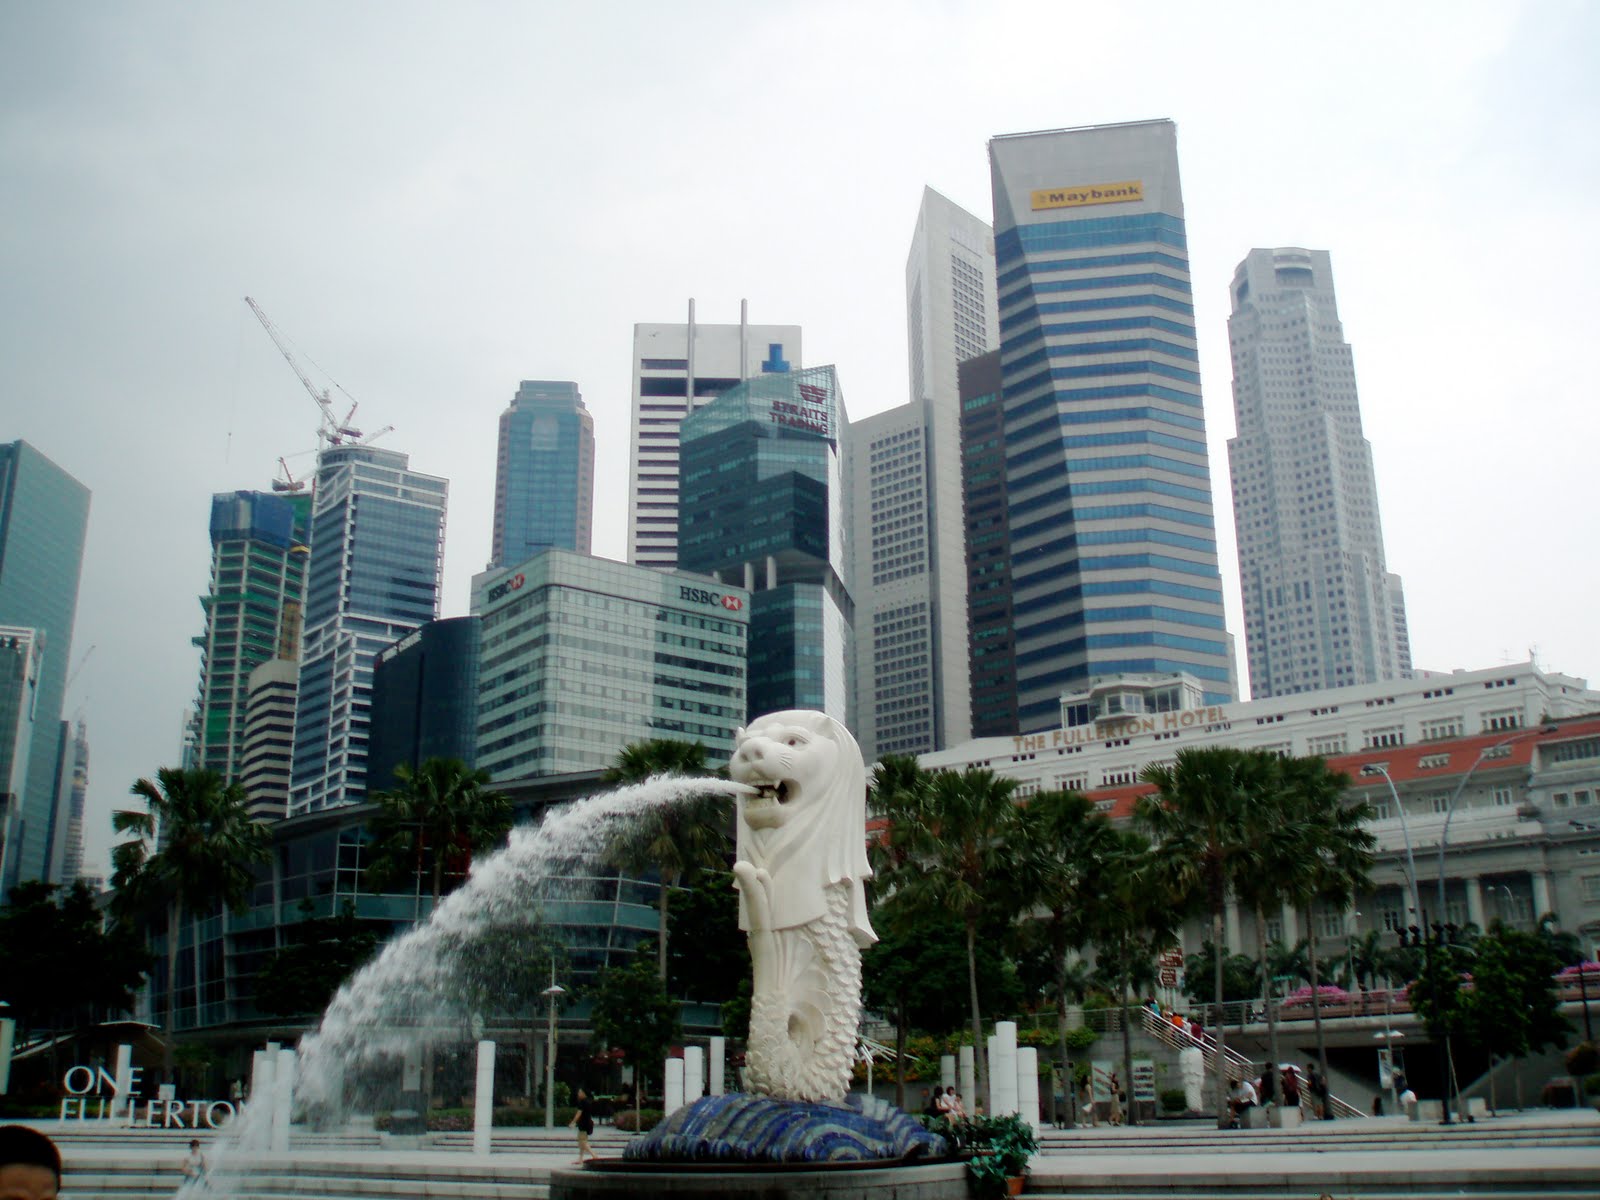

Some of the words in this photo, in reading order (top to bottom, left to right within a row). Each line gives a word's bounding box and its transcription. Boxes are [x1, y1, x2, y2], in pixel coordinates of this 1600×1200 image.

[1049, 187, 1138, 203] Maybank
[772, 401, 828, 423] STRAITS
[769, 412, 828, 435] TRADING
[680, 586, 720, 606] HSBC
[1013, 736, 1046, 753] THE
[1053, 718, 1156, 747] FULLERTON
[1163, 706, 1228, 729] HOTEL
[64, 1066, 144, 1094] ONE
